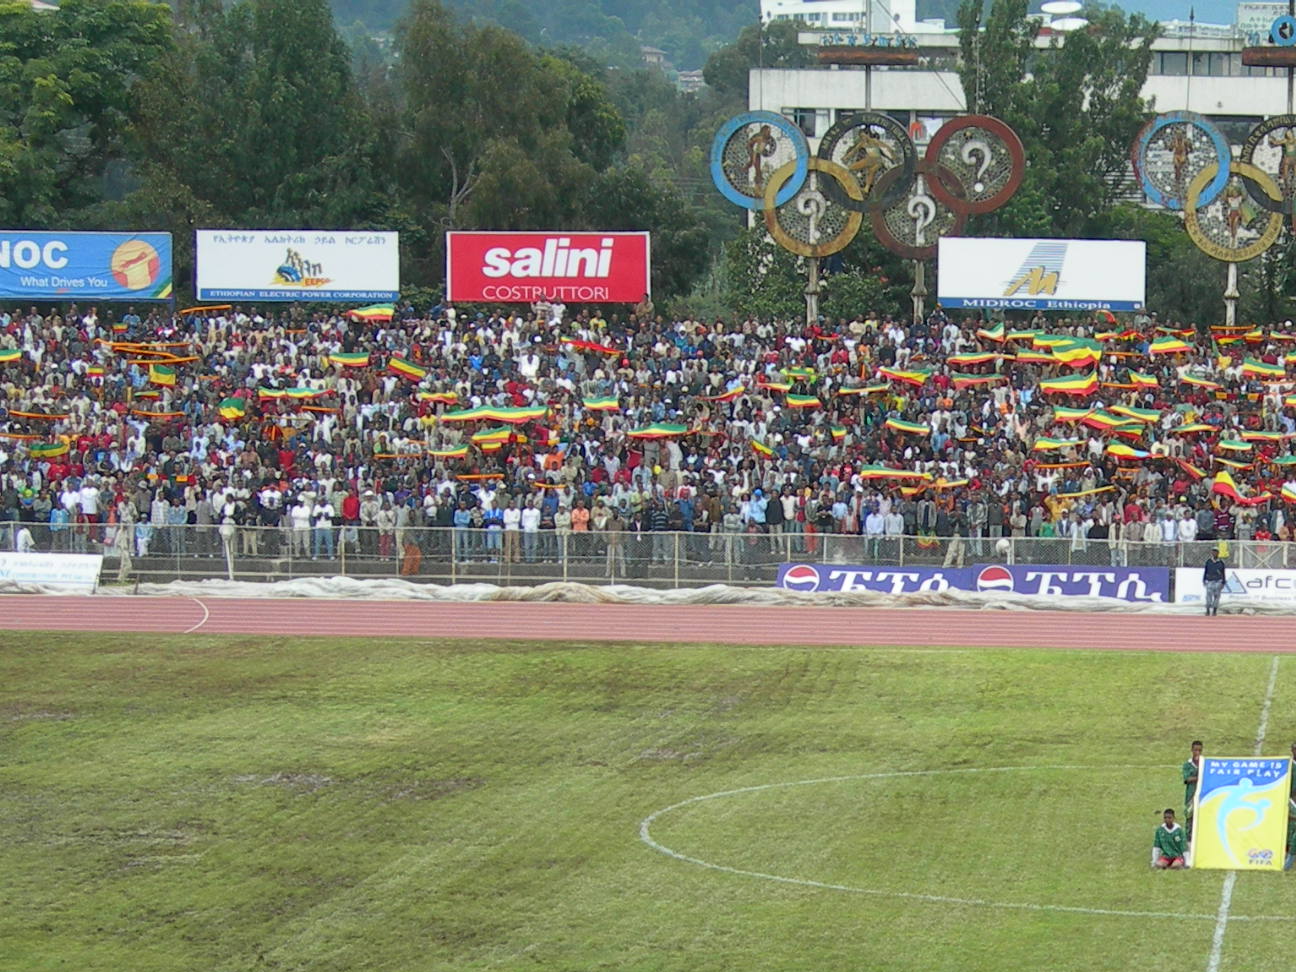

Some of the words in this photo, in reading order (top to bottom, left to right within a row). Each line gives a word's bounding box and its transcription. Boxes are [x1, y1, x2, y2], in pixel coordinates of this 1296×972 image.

[482, 237, 614, 278] salini
[20, 276, 49, 288] What
[51, 276, 85, 288] Drives
[87, 276, 108, 288] You
[482, 285, 609, 300] COSTRUTTORI
[963, 299, 1037, 308] MIDROC
[1047, 299, 1111, 311] Ethiopia
[1247, 769, 1280, 778] PLAY
